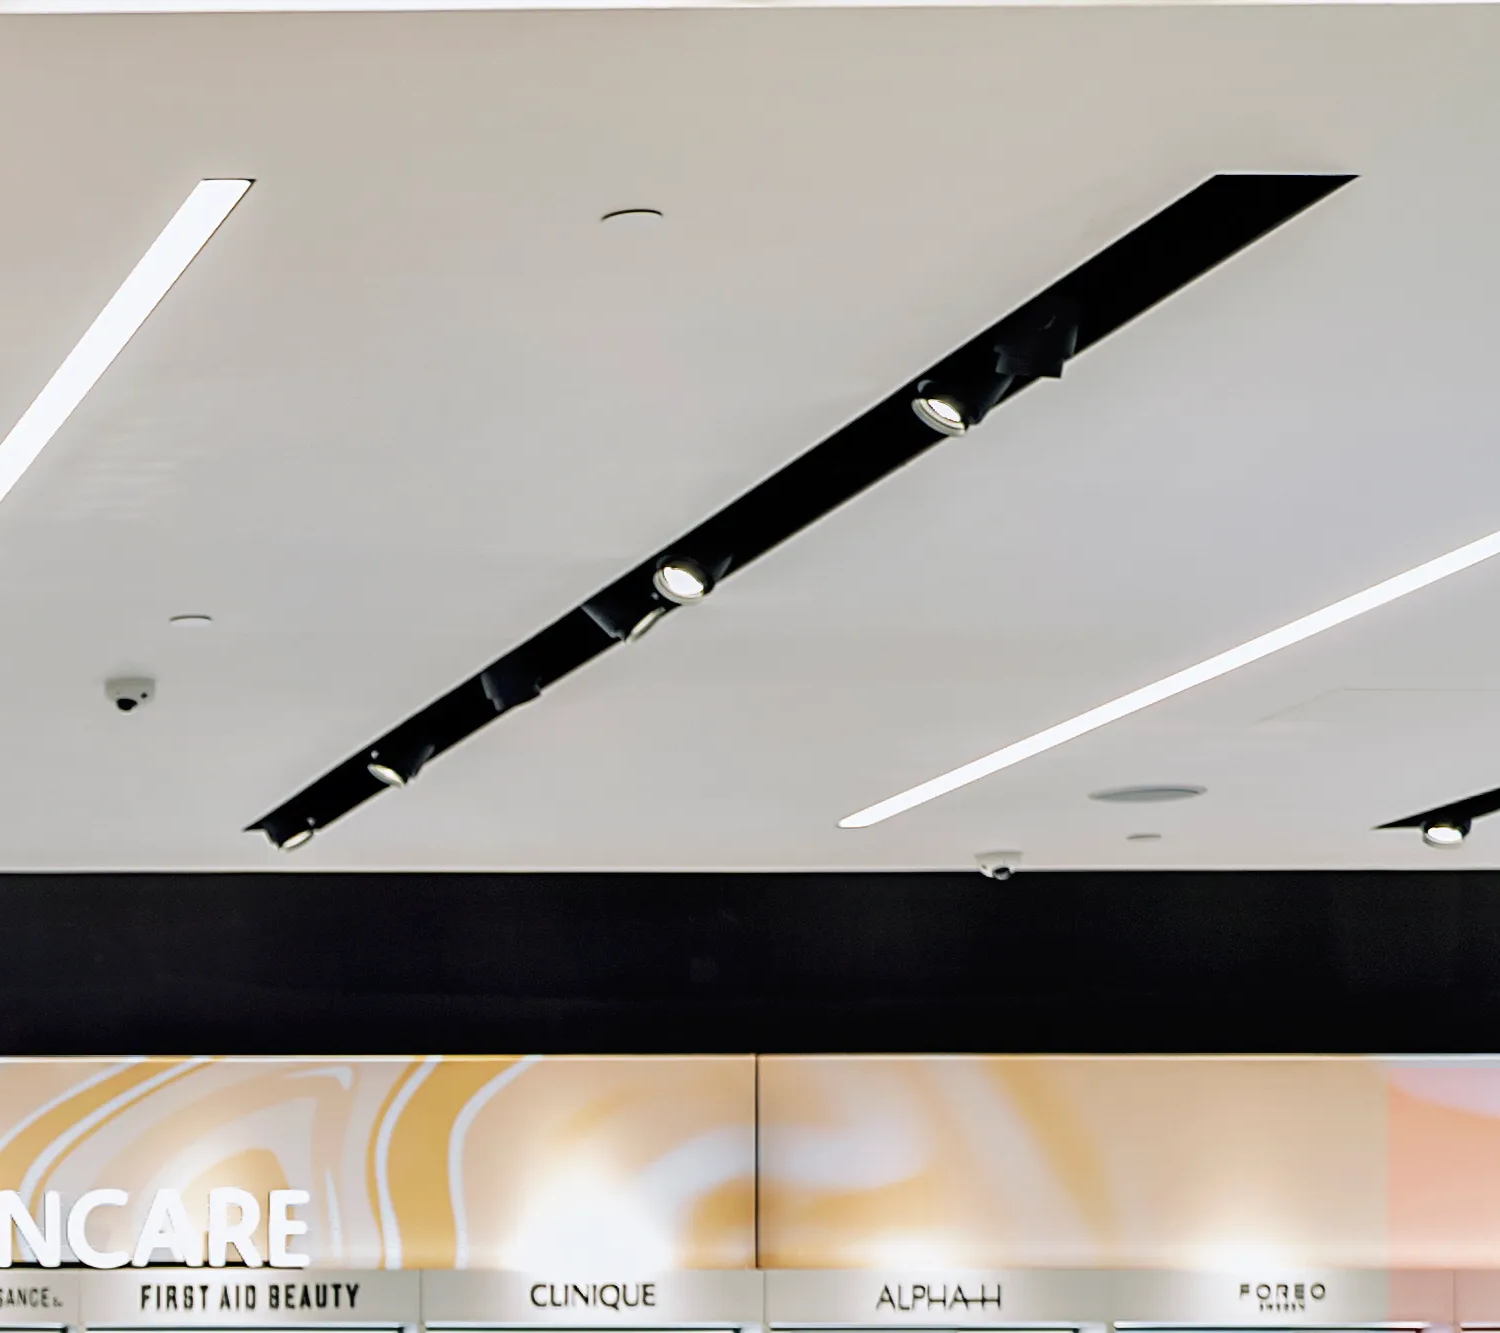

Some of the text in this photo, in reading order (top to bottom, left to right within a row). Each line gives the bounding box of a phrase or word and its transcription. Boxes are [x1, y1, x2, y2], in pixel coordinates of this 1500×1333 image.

[140, 1284, 360, 1310] FIRST AID BEAUTY
[530, 1283, 656, 1310] CLINIQUE
[1239, 1283, 1327, 1300] FOREO
